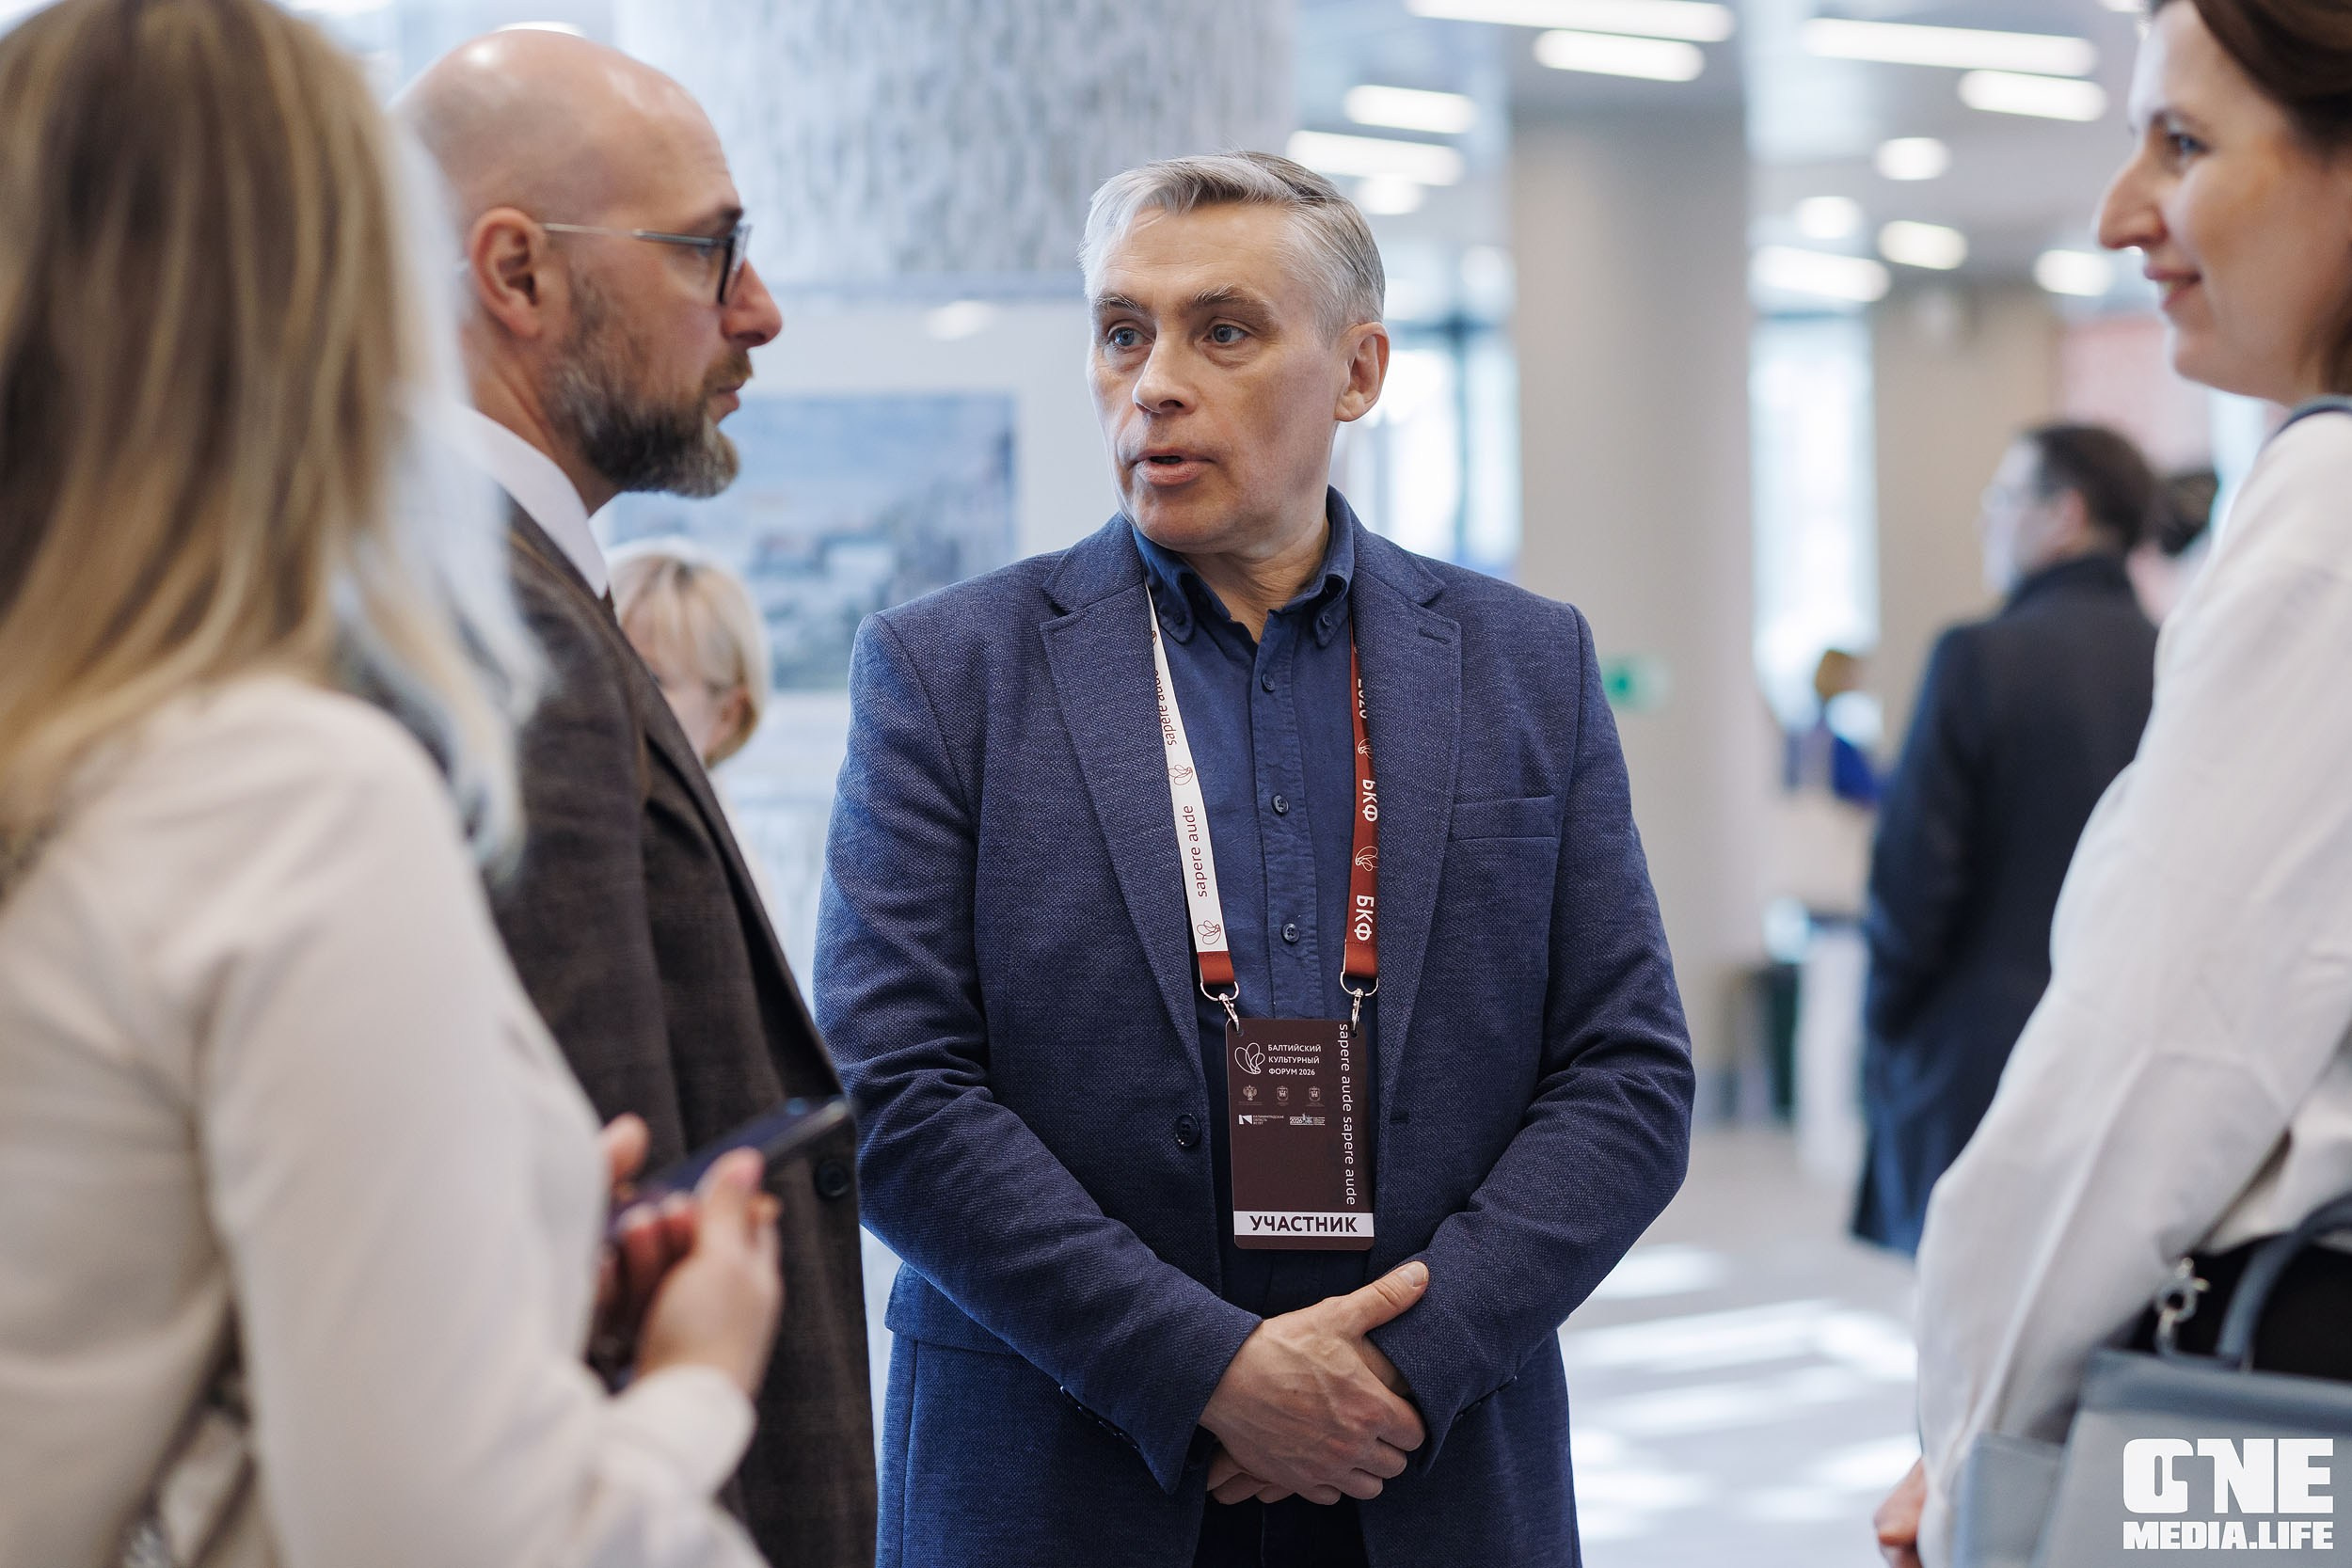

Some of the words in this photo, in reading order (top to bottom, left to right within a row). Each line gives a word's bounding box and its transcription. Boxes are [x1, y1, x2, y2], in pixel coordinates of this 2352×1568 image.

[1159, 705, 1177, 746] sapere
[1183, 805, 1199, 842] aude
[1190, 847, 1207, 897] sapere
[1354, 895, 1375, 941] БКФ
[1267, 1044, 1322, 1053] БАЛТИЙСКИЙ
[1268, 1055, 1320, 1064] КУЛЬТУРНЫЙ
[1338, 1023, 1350, 1071] sapere
[1342, 1076, 1353, 1112] aude
[1341, 1117, 1354, 1164] sapere
[1345, 1169, 1357, 1205] aude
[1249, 1215, 1358, 1232] УЧАСТНИК
